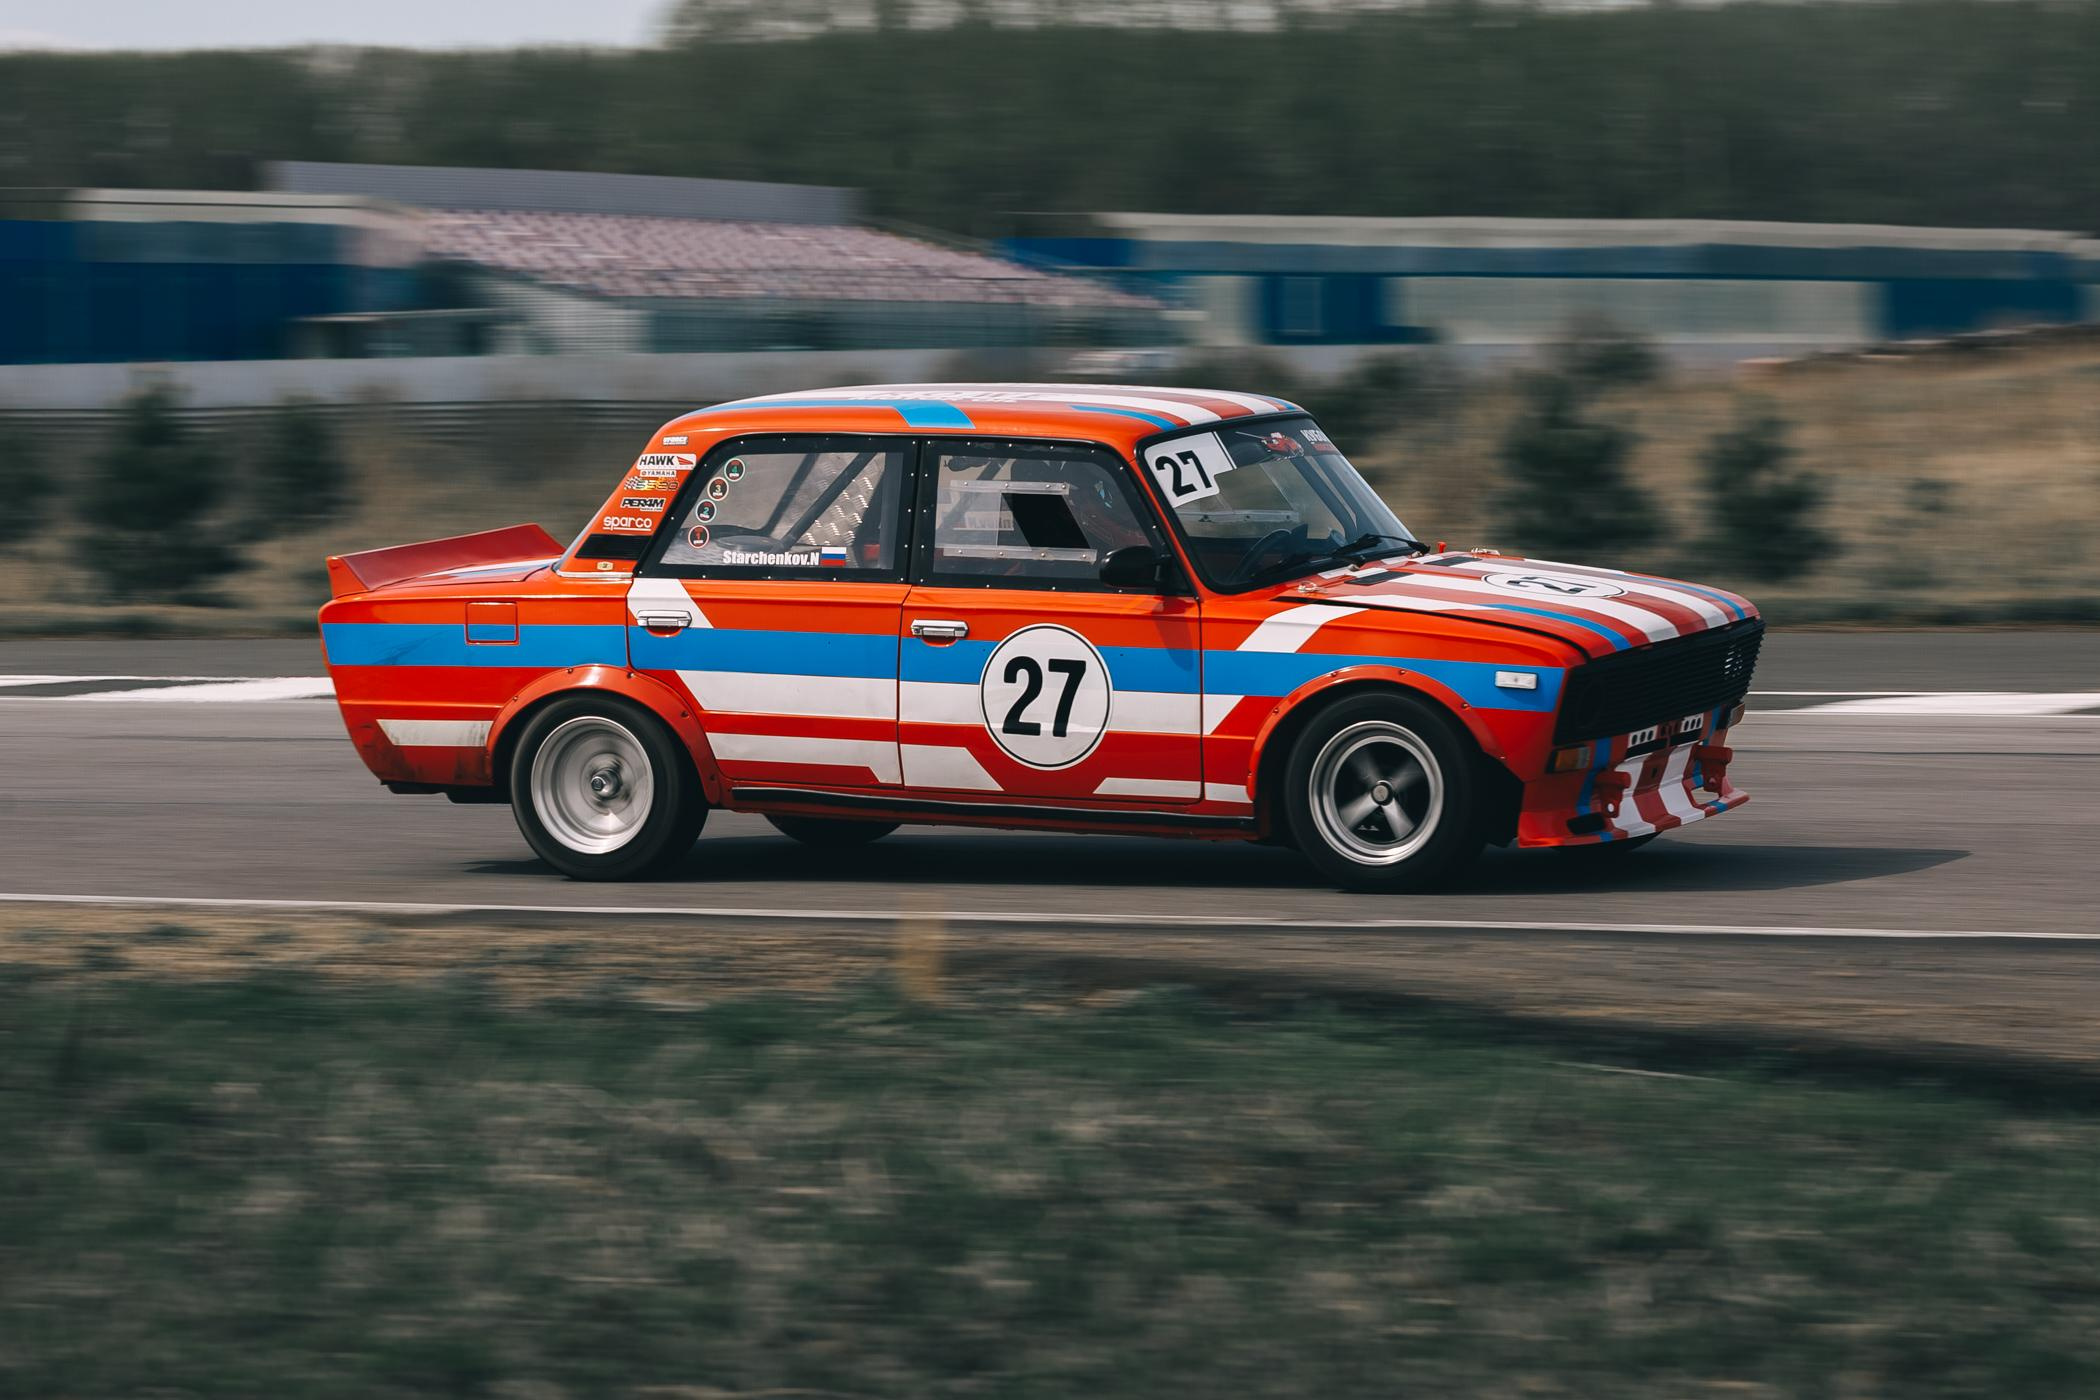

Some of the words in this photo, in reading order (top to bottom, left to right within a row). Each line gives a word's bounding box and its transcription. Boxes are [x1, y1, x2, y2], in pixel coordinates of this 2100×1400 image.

[639, 455, 676, 466] HAWK
[1154, 449, 1213, 497] 27
[714, 484, 721, 493] 3
[703, 506, 709, 515] 2
[603, 516, 653, 531] sparco
[722, 550, 820, 566] Starchenkov.N
[1002, 655, 1087, 738] 27
